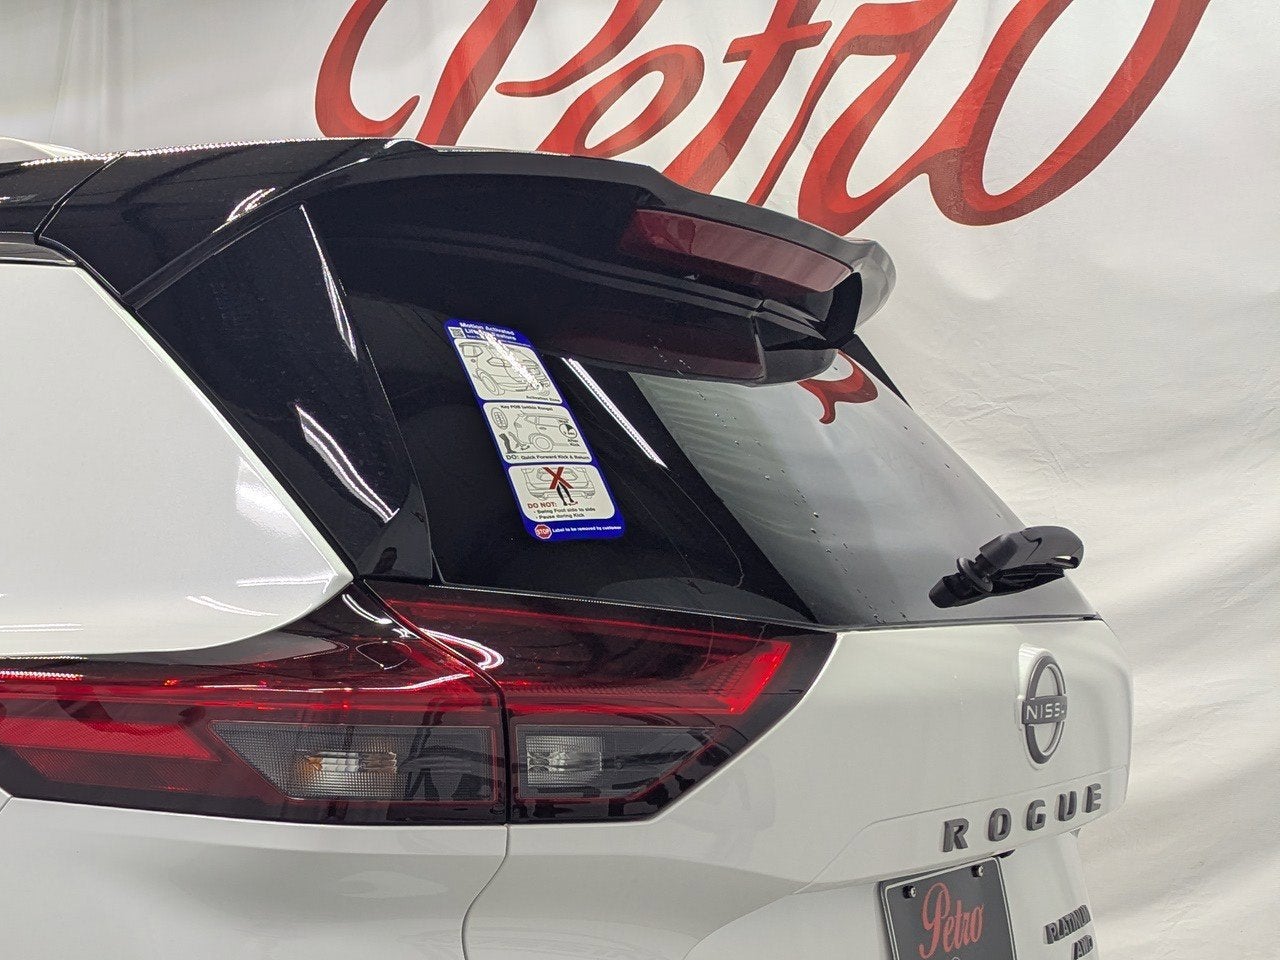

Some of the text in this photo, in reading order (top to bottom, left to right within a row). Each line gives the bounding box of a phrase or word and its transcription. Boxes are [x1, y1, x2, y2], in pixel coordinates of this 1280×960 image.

[485, 326, 515, 336] Activated
[1026, 703, 1065, 720] NISS
[942, 783, 1102, 852] ROGUE
[918, 882, 984, 959] Petro
